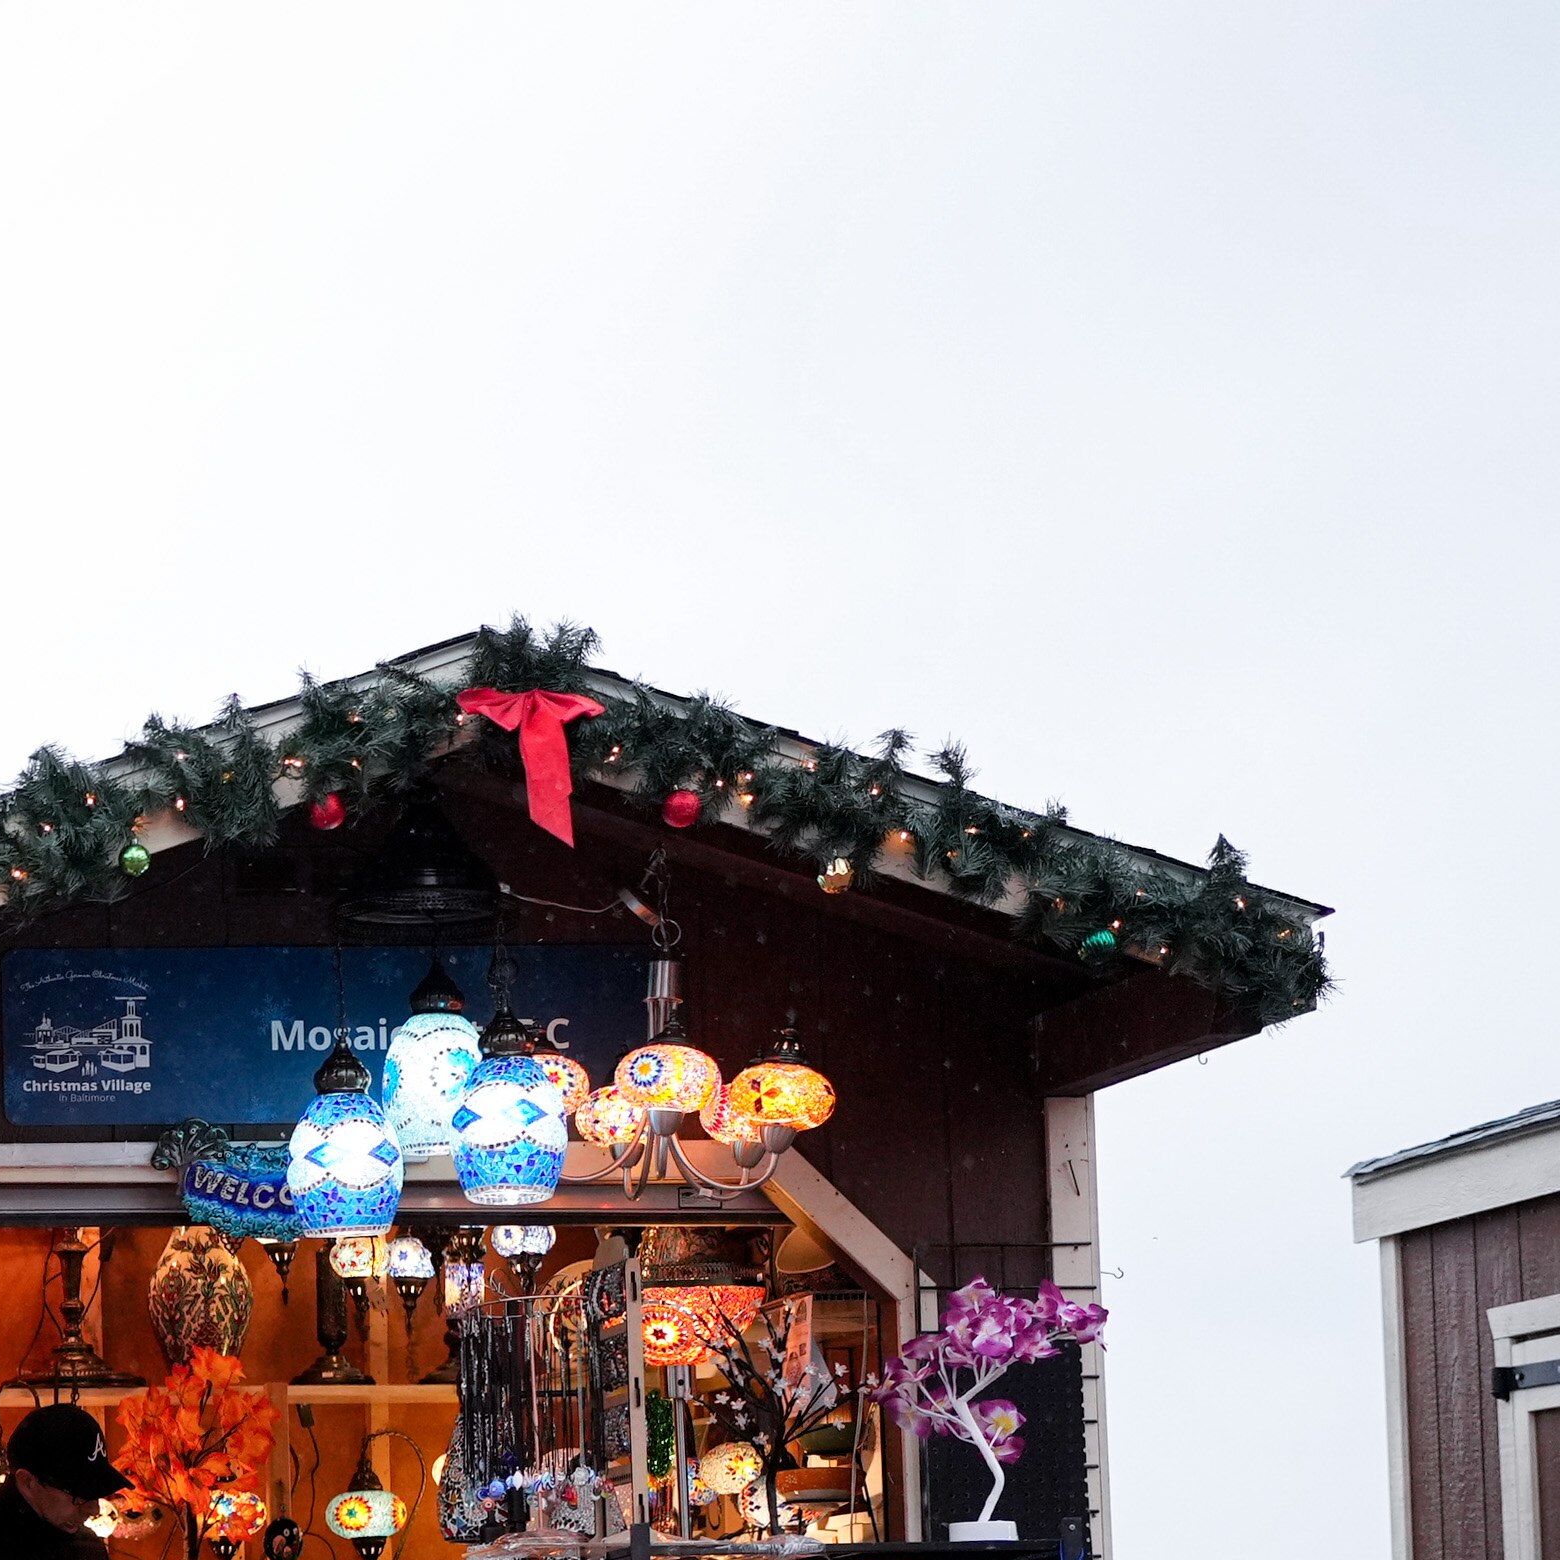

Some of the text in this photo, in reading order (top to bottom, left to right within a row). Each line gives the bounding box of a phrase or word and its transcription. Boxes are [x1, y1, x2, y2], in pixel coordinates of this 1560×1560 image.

[22, 1079, 151, 1094] Christmas Village
[70, 1093, 116, 1102] Baltimore
[194, 1166, 295, 1209] WELCO
